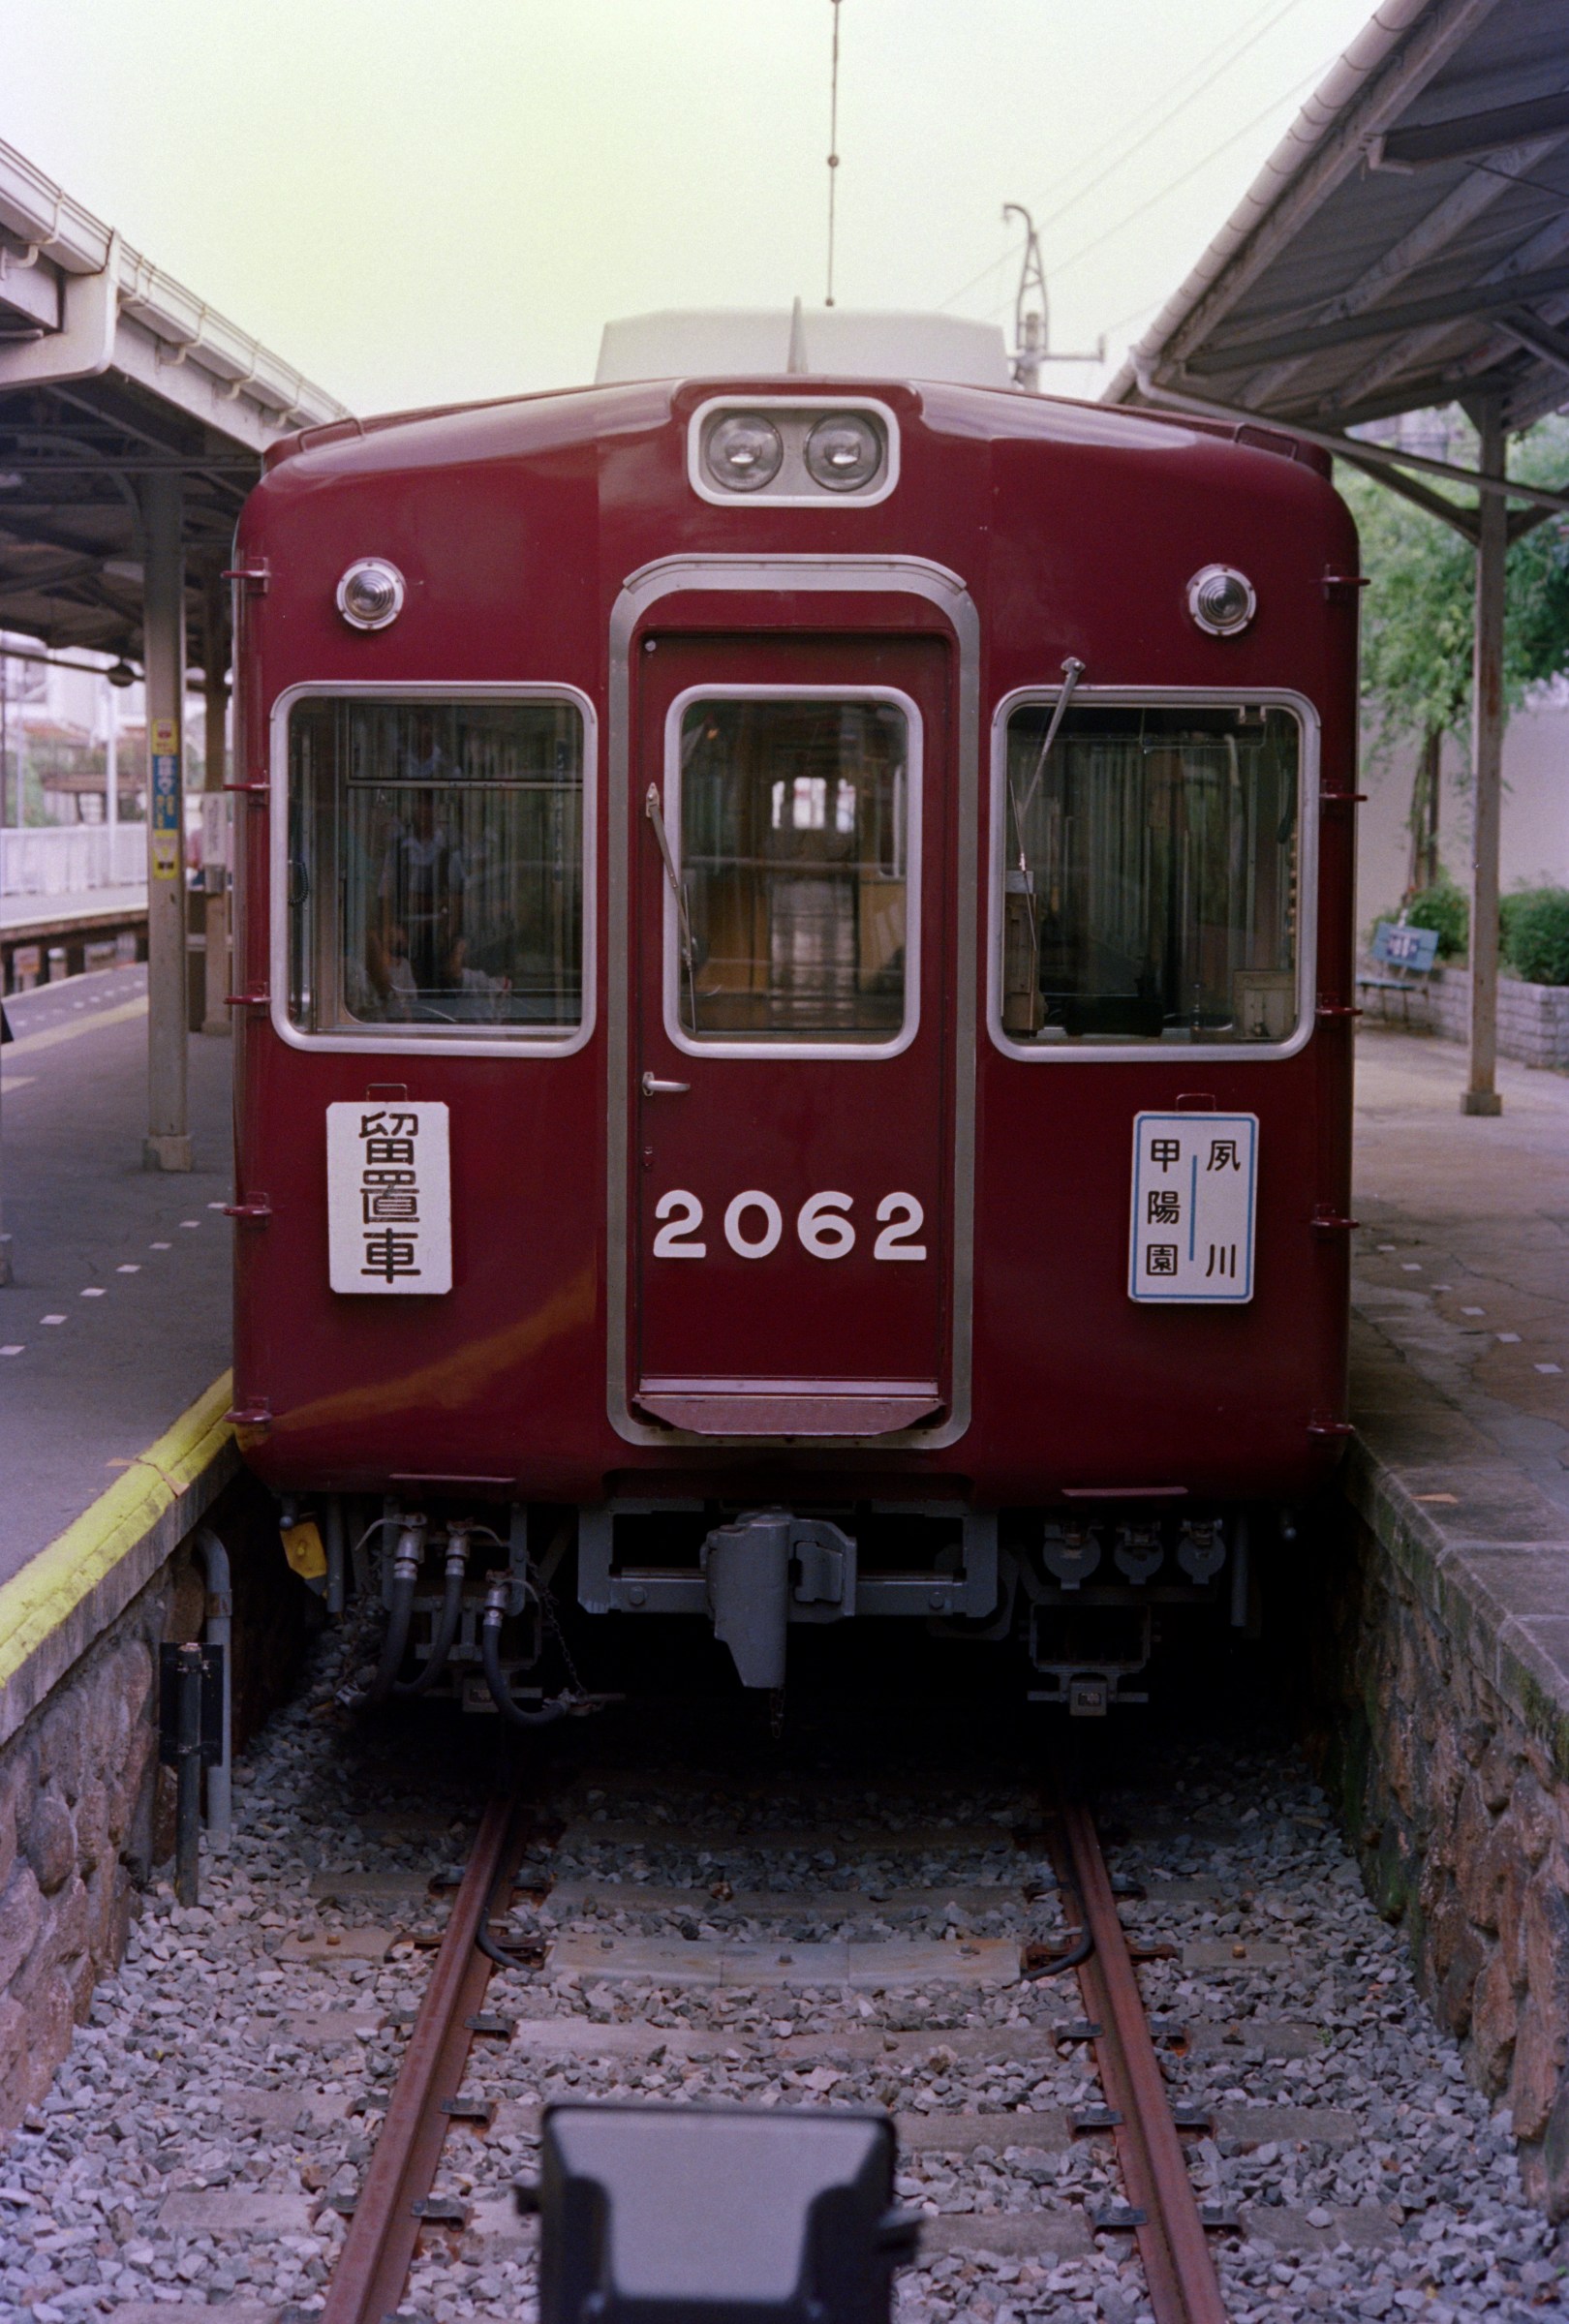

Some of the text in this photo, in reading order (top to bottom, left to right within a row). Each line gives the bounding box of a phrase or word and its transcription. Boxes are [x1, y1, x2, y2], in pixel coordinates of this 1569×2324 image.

[358, 1111, 421, 1284] 留置車
[653, 1189, 927, 1261] 2062
[1146, 1139, 1181, 1276] 甲陽園
[1205, 1140, 1241, 1278] 夙川
